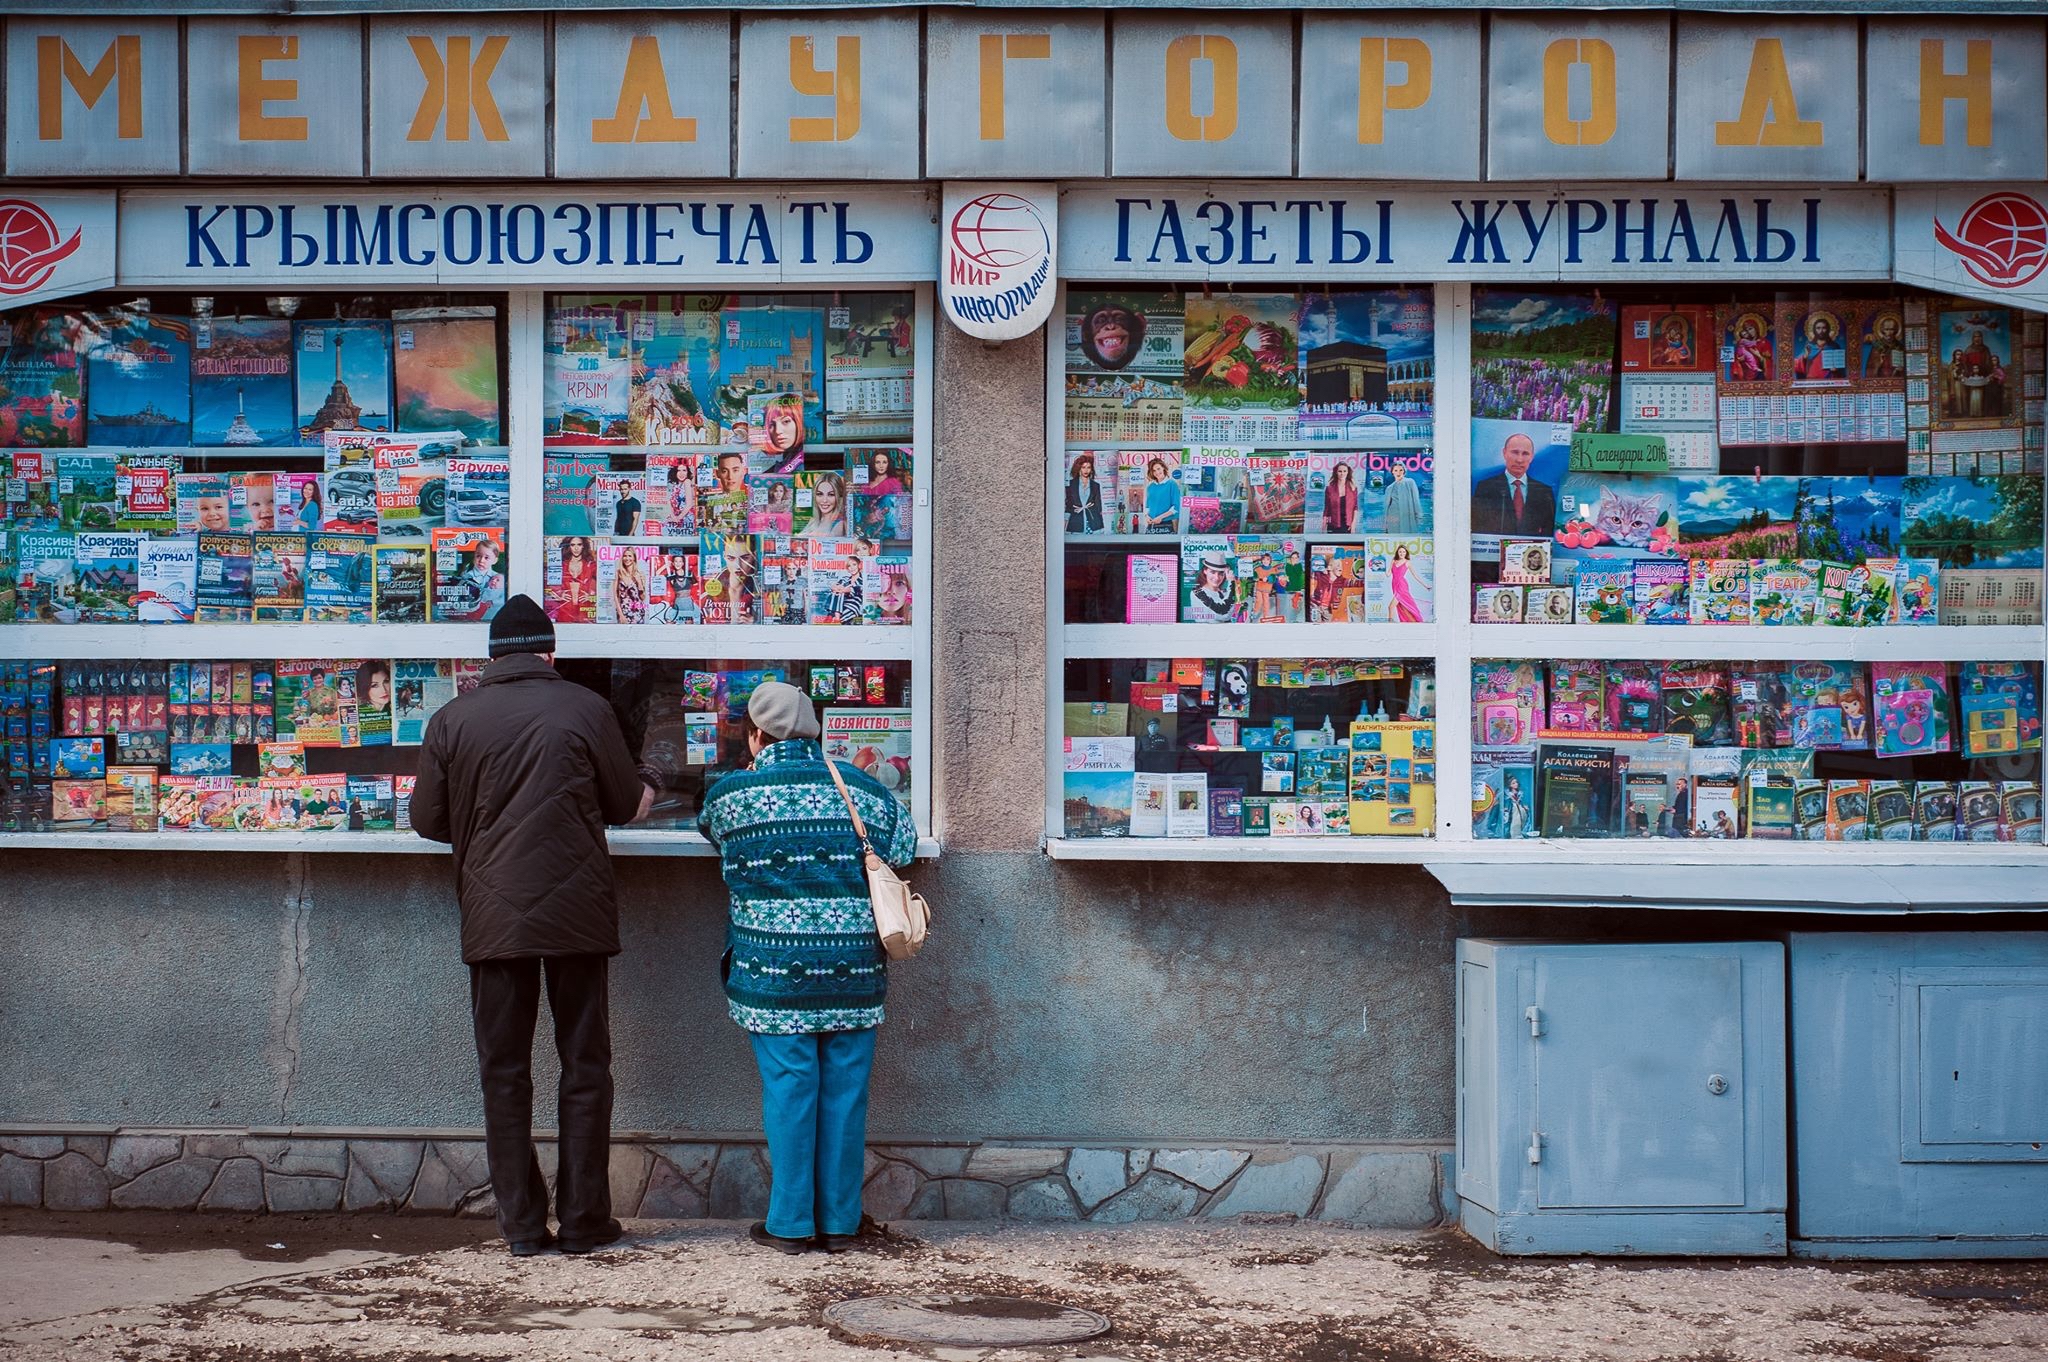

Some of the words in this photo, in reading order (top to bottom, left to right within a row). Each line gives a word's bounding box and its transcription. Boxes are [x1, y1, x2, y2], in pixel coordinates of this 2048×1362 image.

[185, 201, 874, 268] КРЫМСОЮЗПЕЧАТЬ
[1113, 198, 1395, 265] ГАЗЕТЫ
[1447, 198, 1823, 265] ЖУРНАЛЫ
[951, 256, 1051, 324] ИНФОРМАЦИИ
[577, 357, 599, 371] 2016
[567, 382, 609, 399] КРЫМ
[645, 418, 707, 446] Крым
[1200, 445, 1240, 458] burda
[1646, 444, 1667, 463] 2016
[16, 458, 39, 467] ИДЕИ
[58, 458, 93, 470] САД
[127, 458, 170, 467] ДАЧНЫЕ
[392, 457, 416, 467] РЕВЮ
[543, 458, 606, 477] Forbes
[1192, 456, 1248, 467] ПЭЧВОРК
[16, 470, 39, 480] ДОМА
[134, 476, 164, 487] ИДЕИ
[133, 494, 165, 505] ДОМА
[395, 495, 421, 507] лето
[1183, 498, 1195, 506] 21
[1184, 544, 1228, 552] крючком
[147, 553, 193, 562] ЖУРНАЛ
[811, 558, 848, 570] Домашни
[1635, 564, 1685, 577] ШКОЛА
[1752, 562, 1818, 580] Волшебный
[383, 581, 421, 589] ЛОНДОН
[1580, 572, 1628, 586] УРОКИ
[1712, 578, 1747, 592] СОВ
[1765, 576, 1810, 590] ТЕАТР
[437, 602, 470, 610] ТРОН
[278, 659, 333, 673] Заготовки
[394, 661, 438, 679] ЗОЖ
[1486, 666, 1516, 685] arbie
[827, 715, 890, 730] ХОЗЯЙСТВО
[1557, 750, 1598, 760] Коллекция
[1543, 758, 1573, 768] АГАТА
[1574, 758, 1611, 769] КРИСТИ
